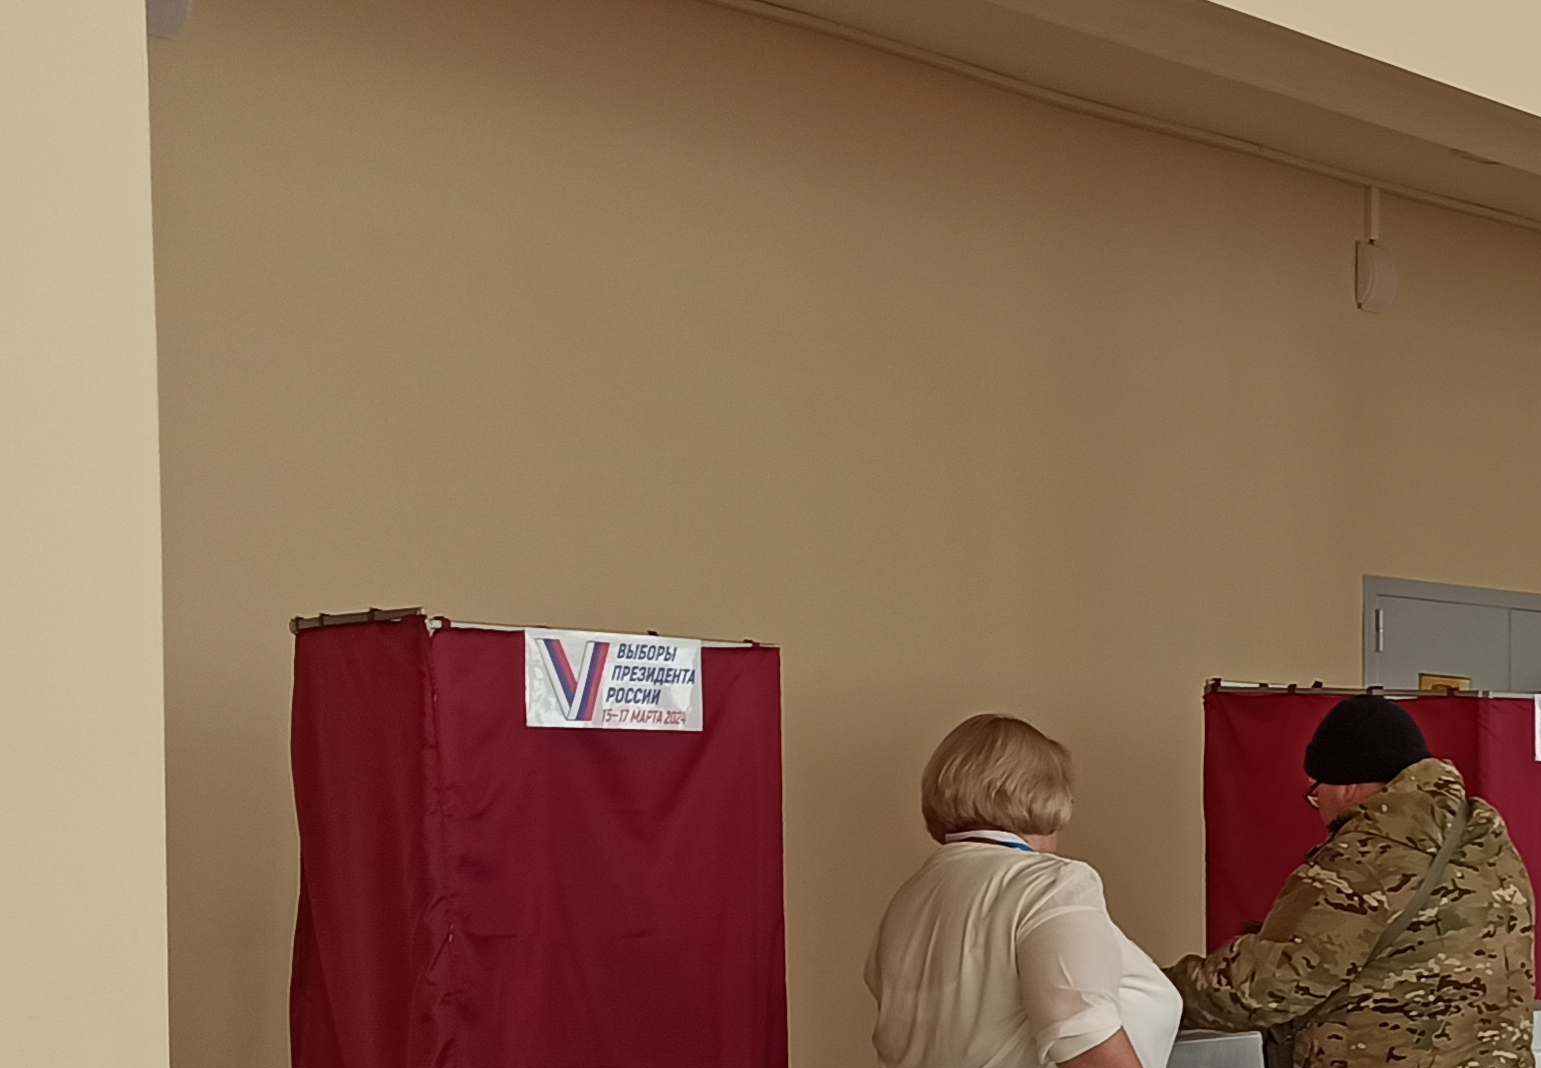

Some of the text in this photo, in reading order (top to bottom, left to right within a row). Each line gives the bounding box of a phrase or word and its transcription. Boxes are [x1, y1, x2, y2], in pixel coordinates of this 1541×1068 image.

[617, 642, 677, 662] ВЫБОРЫ
[612, 665, 696, 685] ПРЕЗИДЕНТА
[605, 687, 661, 705] РОССИИ
[630, 709, 663, 724] МАРТА
